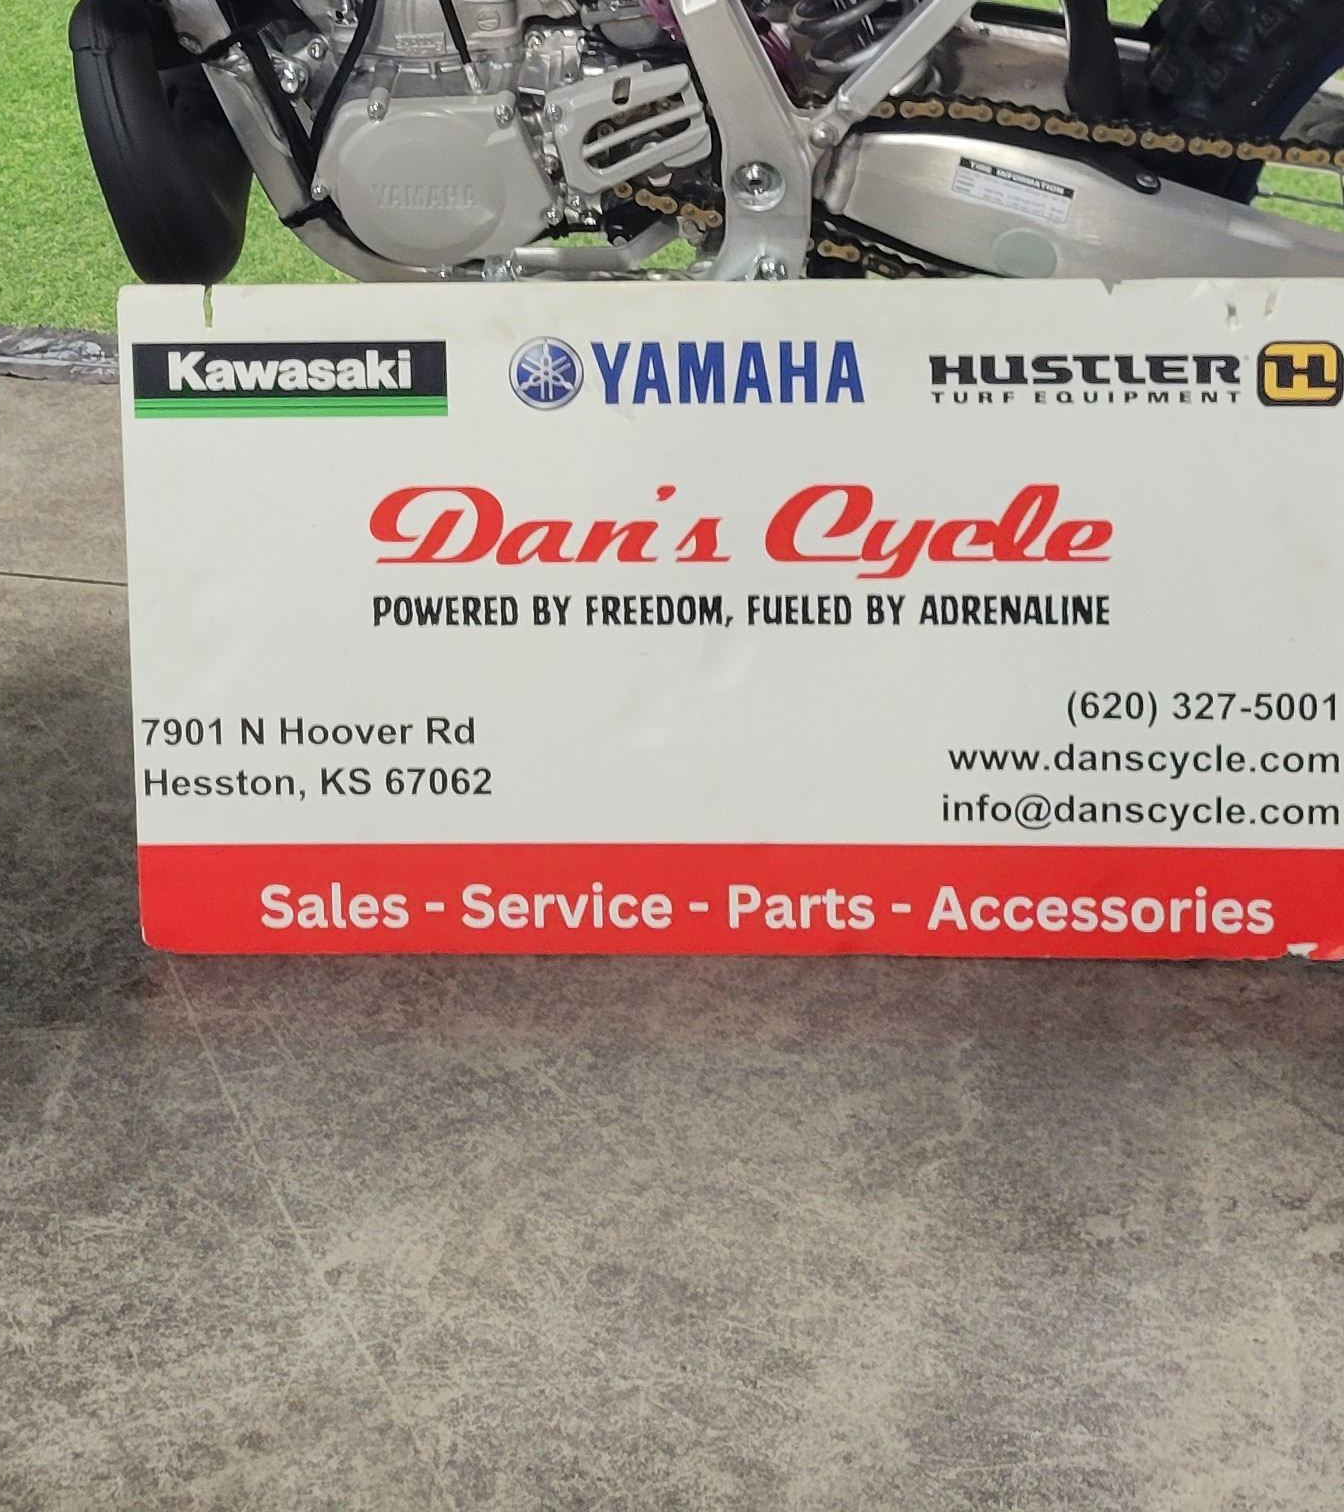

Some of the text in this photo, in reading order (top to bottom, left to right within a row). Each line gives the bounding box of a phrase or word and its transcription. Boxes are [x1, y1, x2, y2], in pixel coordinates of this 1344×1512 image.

[371, 184, 478, 208] YAMAHA
[167, 349, 412, 392] Kawasaki
[591, 341, 864, 403] YAMAHA
[928, 354, 1241, 385] HUSTLER
[931, 391, 1240, 404] TURF EQUIPMENT
[369, 483, 1114, 580] Dan's Cycle
[373, 594, 1110, 628] POWERED BY FREEDOM, FUELED BY ADRENALINE
[1067, 690, 1336, 728] (620) 327-5001
[141, 716, 475, 746] 7901 N Hoover Rd
[948, 743, 1340, 780] www.danscycle.com
[144, 767, 492, 801] Hesston, KS 67062
[942, 793, 1339, 832] info@danscycle.com
[260, 881, 409, 929] Sales
[461, 881, 673, 929] Service
[728, 884, 875, 930] Parts
[927, 885, 1274, 935] Accessories
